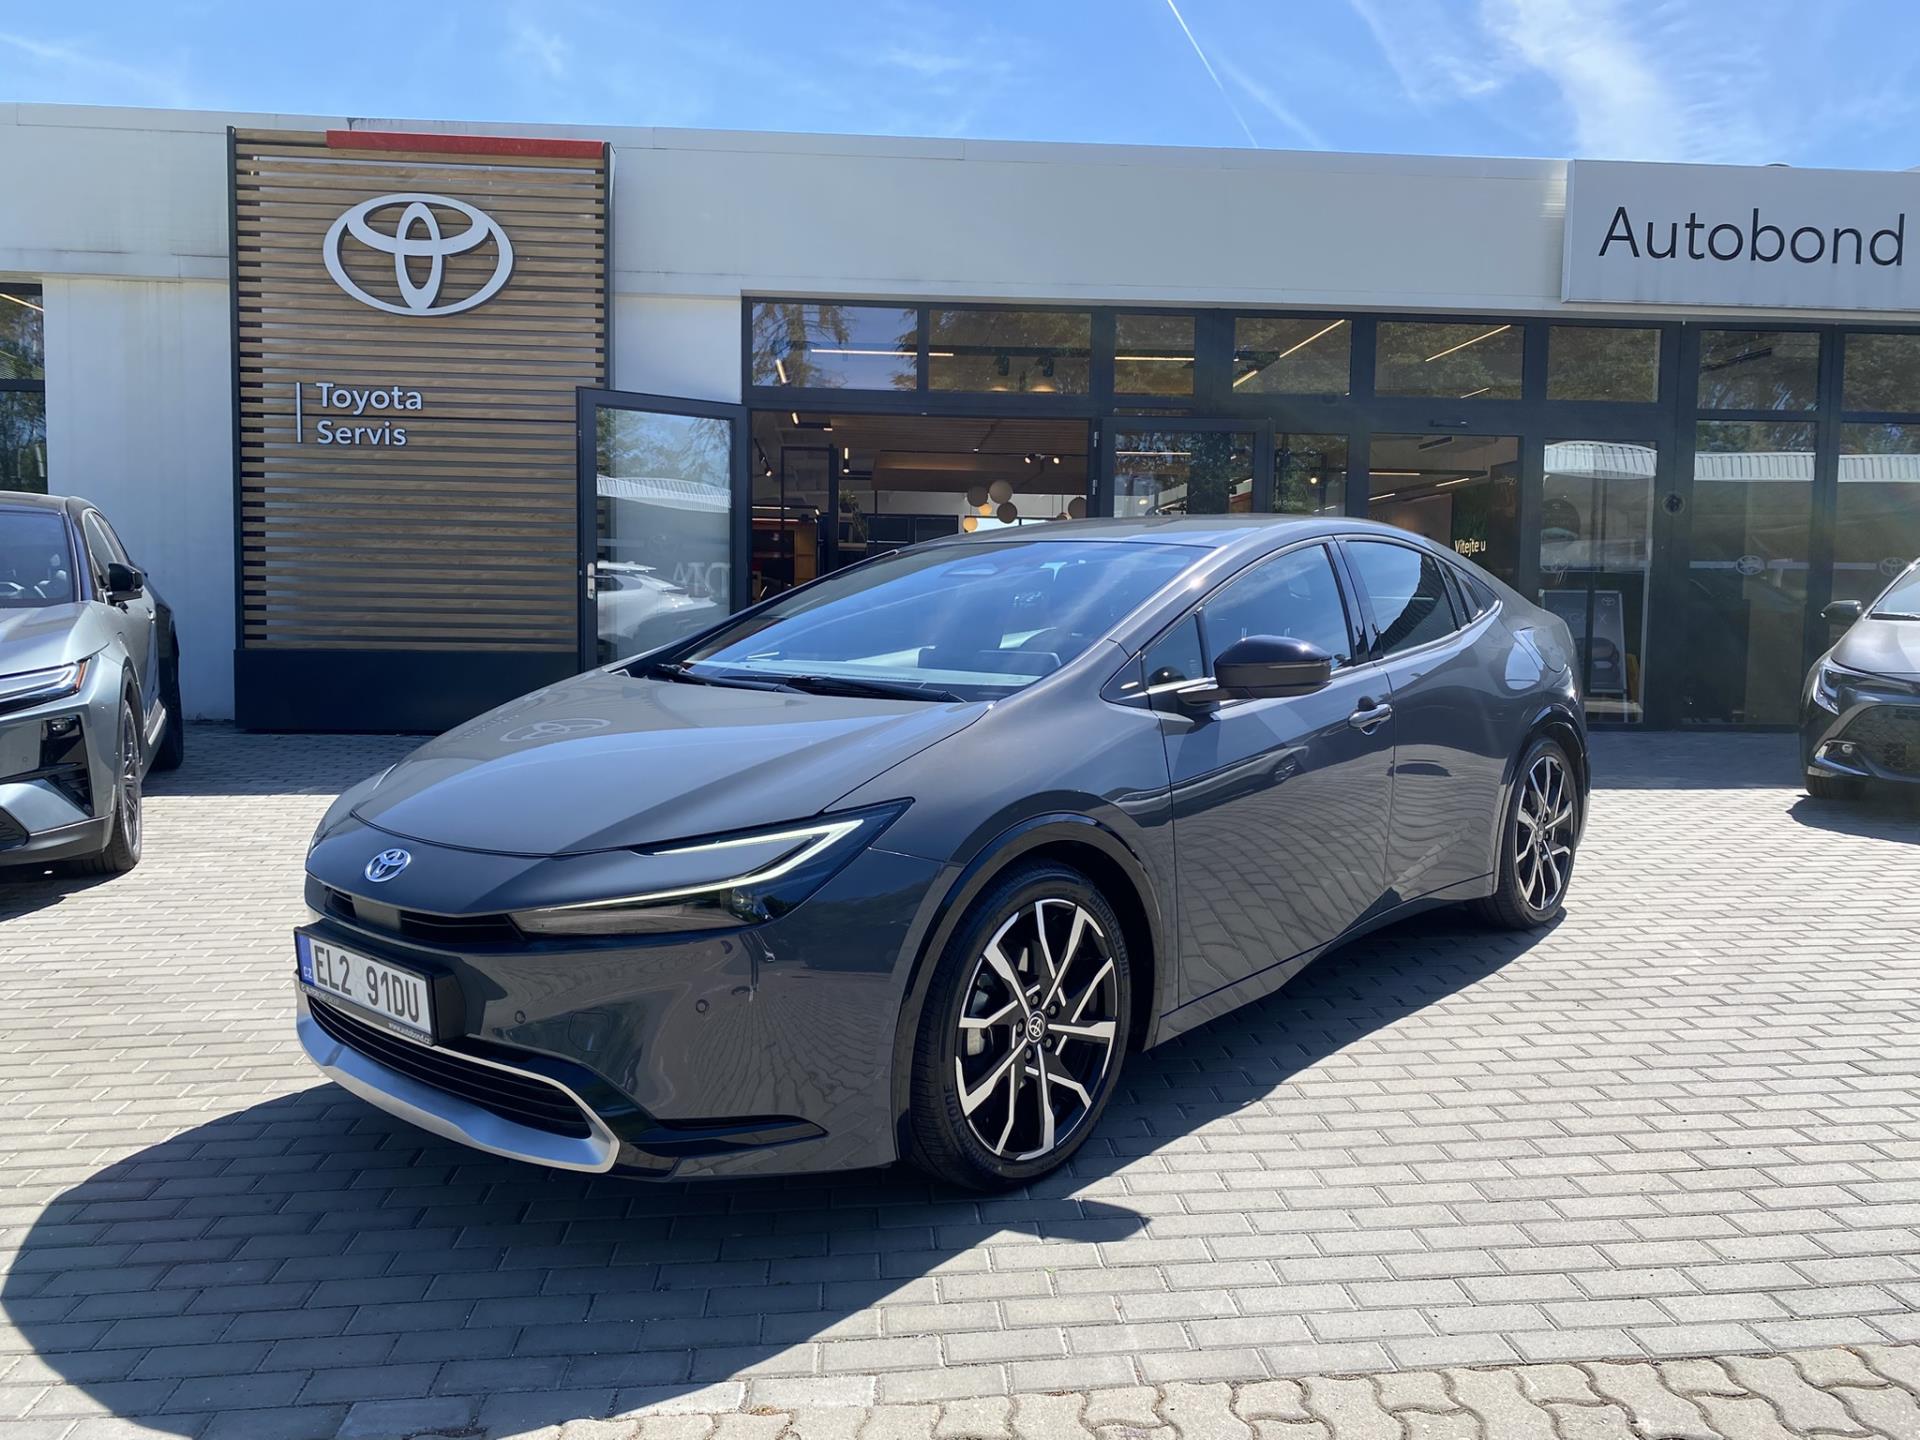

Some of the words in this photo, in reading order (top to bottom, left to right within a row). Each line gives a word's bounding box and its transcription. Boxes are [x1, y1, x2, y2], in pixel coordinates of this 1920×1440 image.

[1598, 206, 1905, 266] Autobond
[316, 382, 424, 415] Toyota
[316, 419, 407, 446] Servis
[314, 945, 352, 996] EL2
[366, 966, 420, 1023] 91DU
